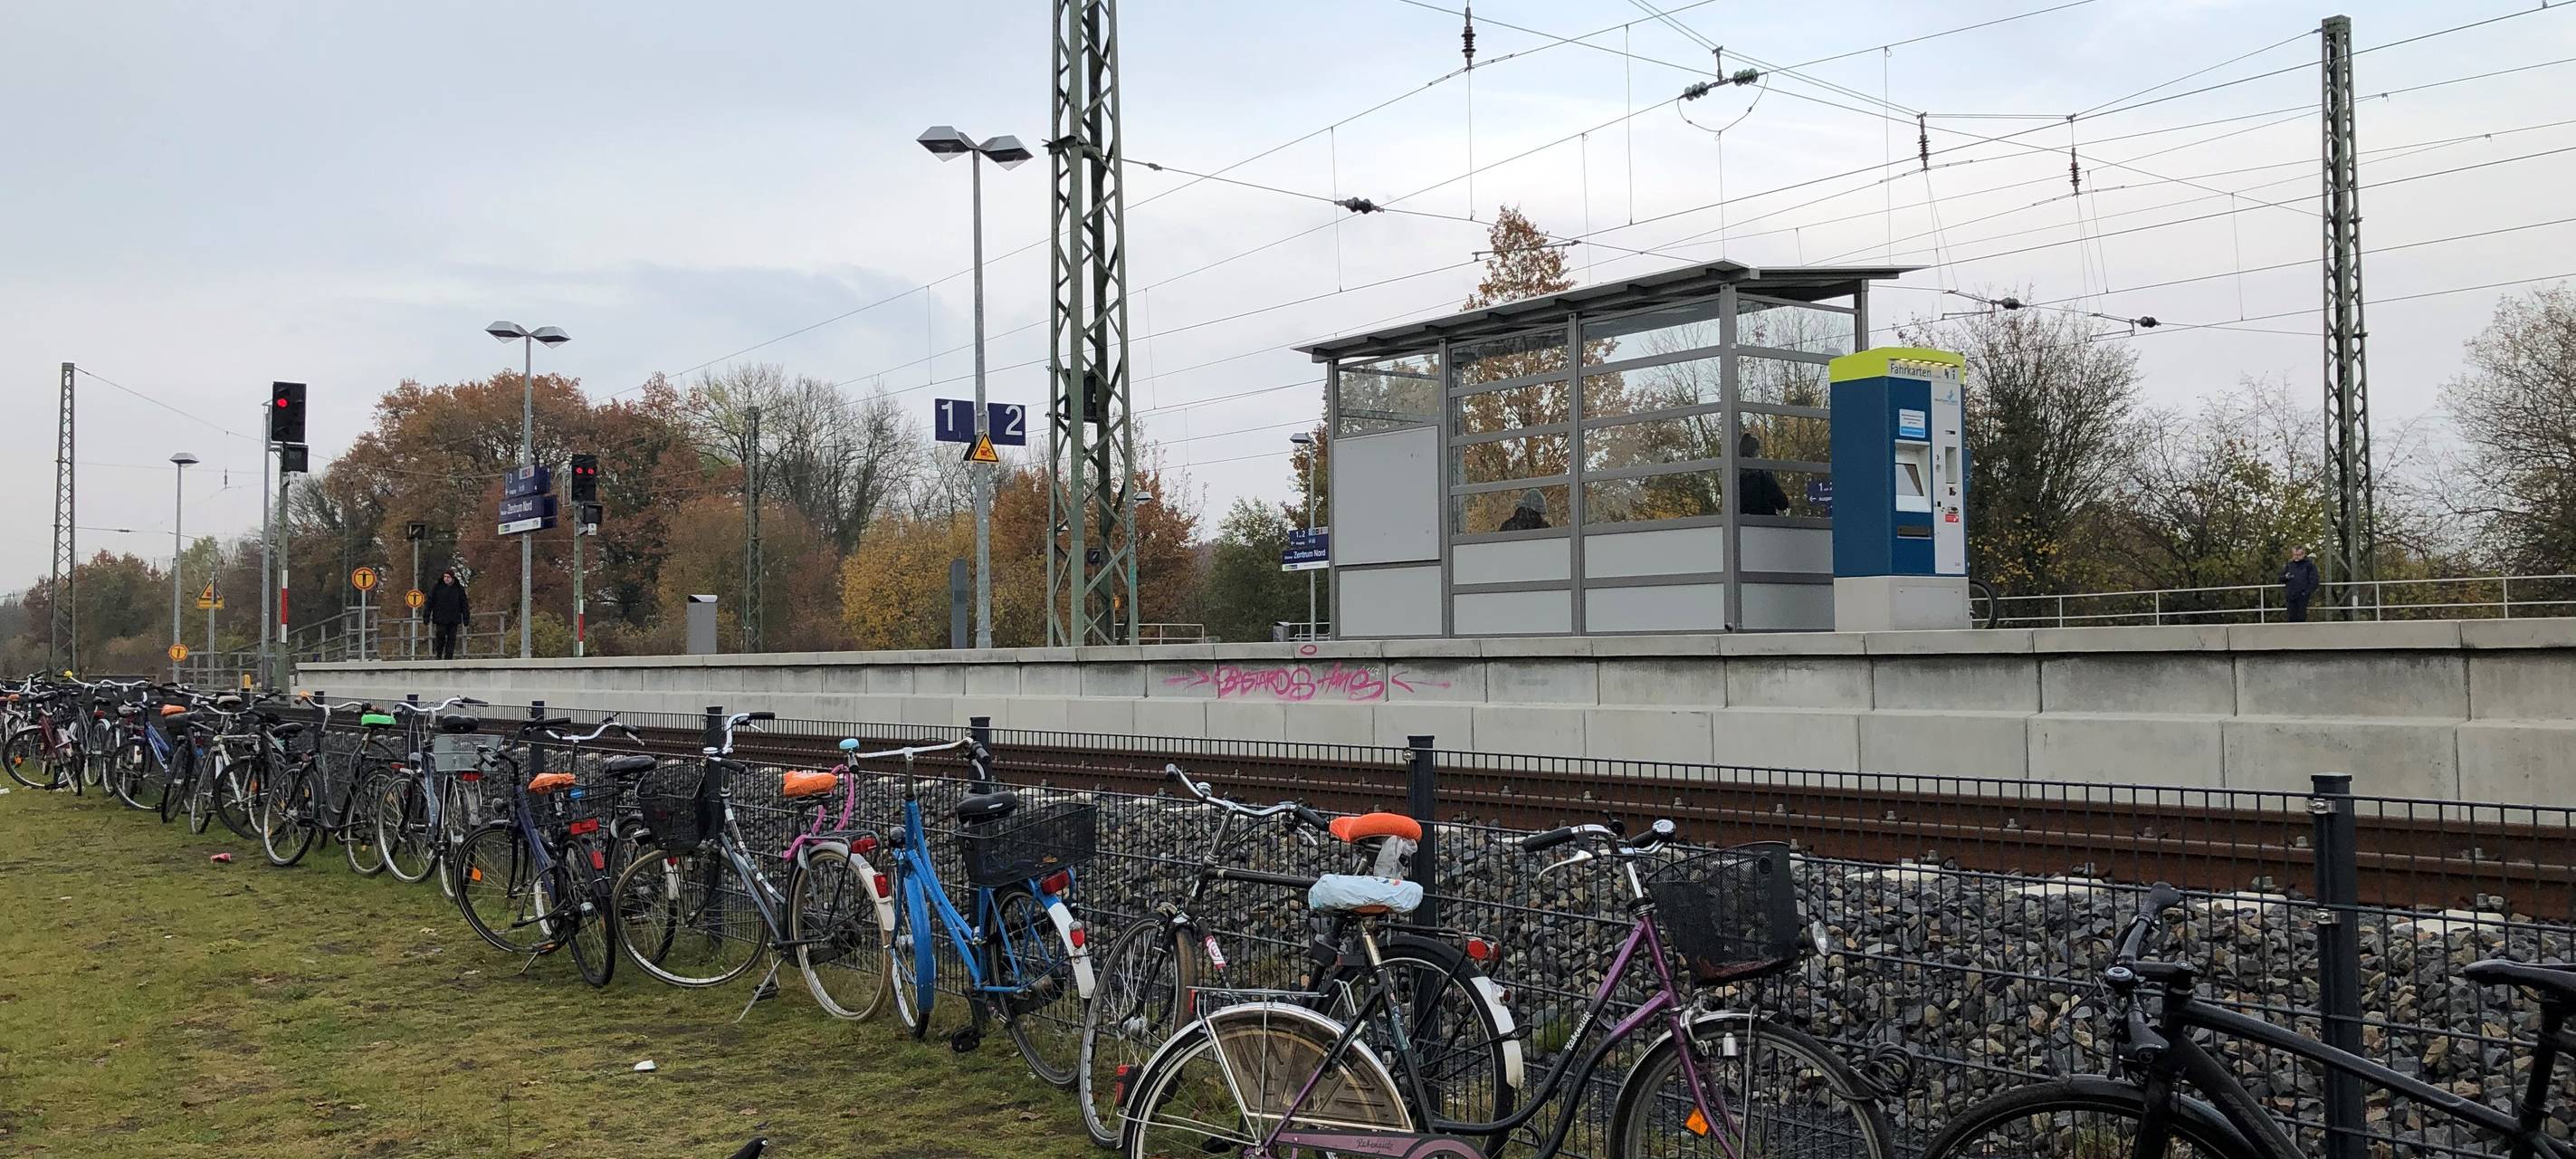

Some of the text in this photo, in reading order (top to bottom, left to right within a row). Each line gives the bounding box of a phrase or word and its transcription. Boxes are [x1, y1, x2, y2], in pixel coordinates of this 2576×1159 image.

[1890, 363, 1932, 378] Fahrkarten
[941, 400, 1023, 436] 1 2
[1293, 548, 1326, 560] Zentrum Nord
